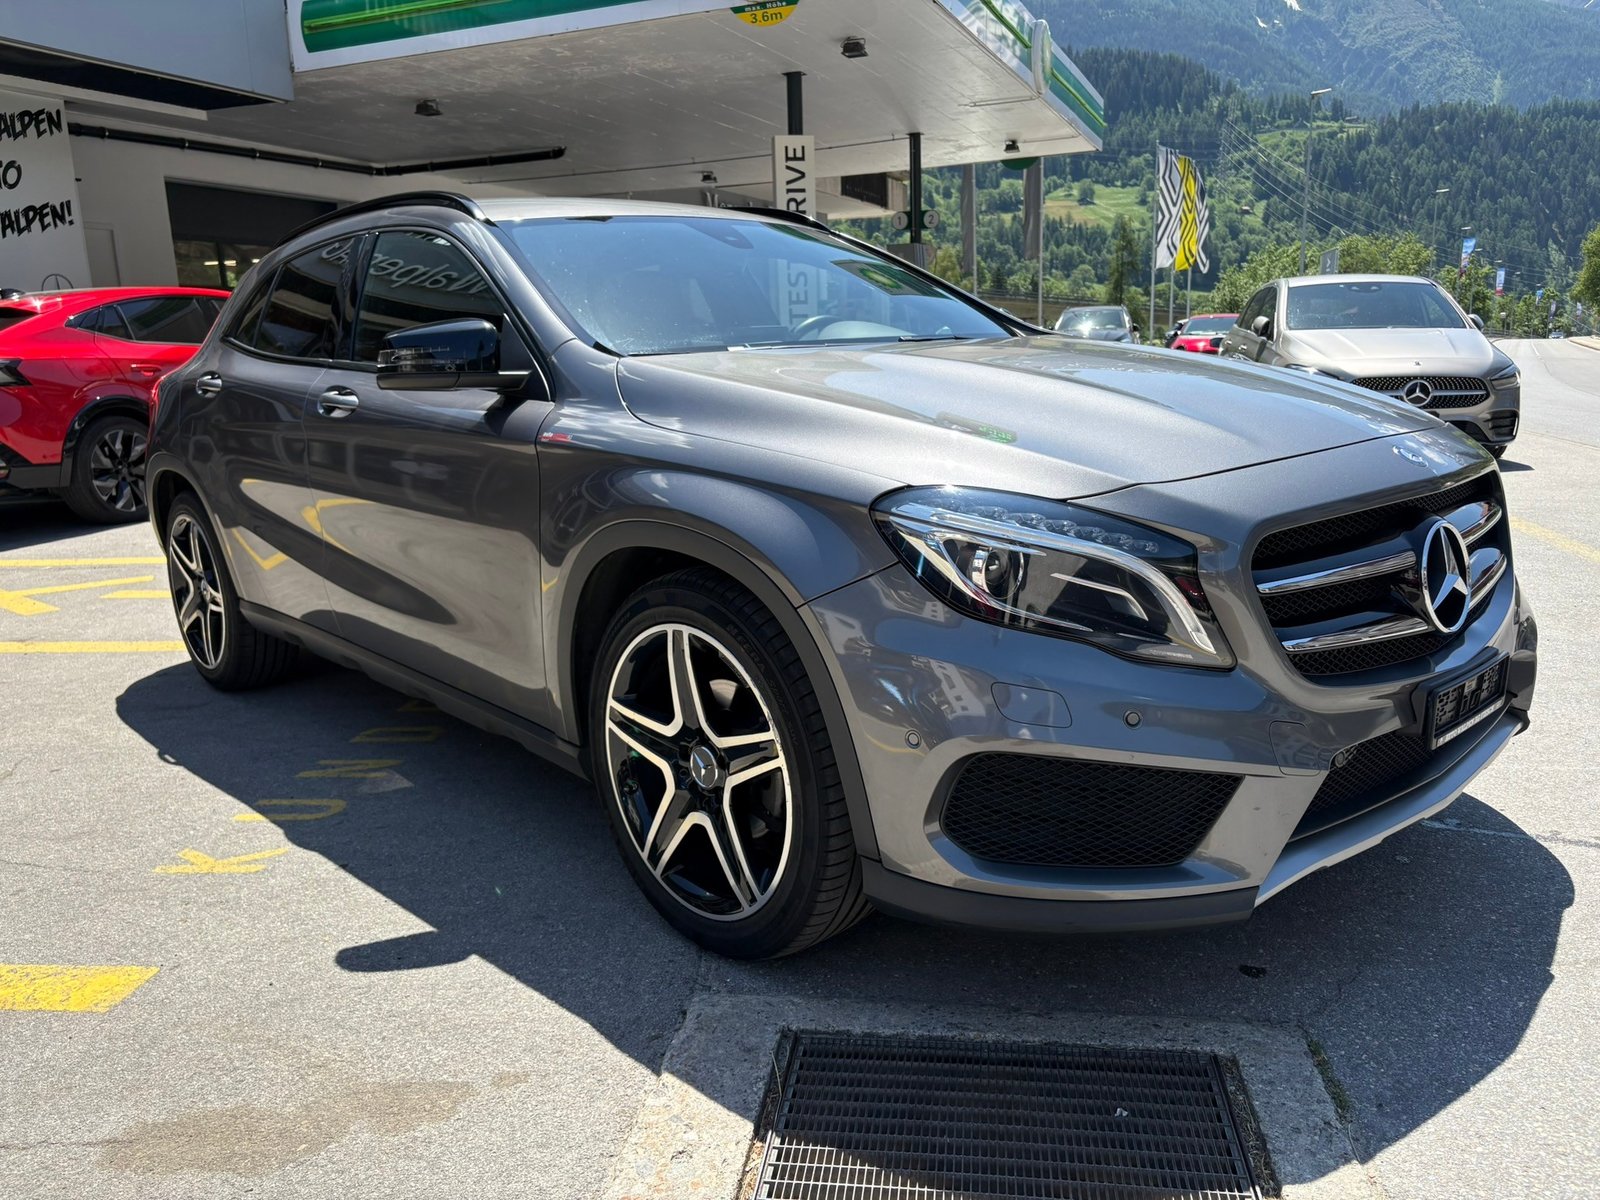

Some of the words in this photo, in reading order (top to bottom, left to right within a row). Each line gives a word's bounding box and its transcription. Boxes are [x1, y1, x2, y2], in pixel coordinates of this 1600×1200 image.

[750, 11, 783, 24] 3.6m
[0, 160, 22, 189] O
[928, 214, 935, 225] 2
[787, 262, 809, 326] TES
[153, 698, 446, 874] KUND
